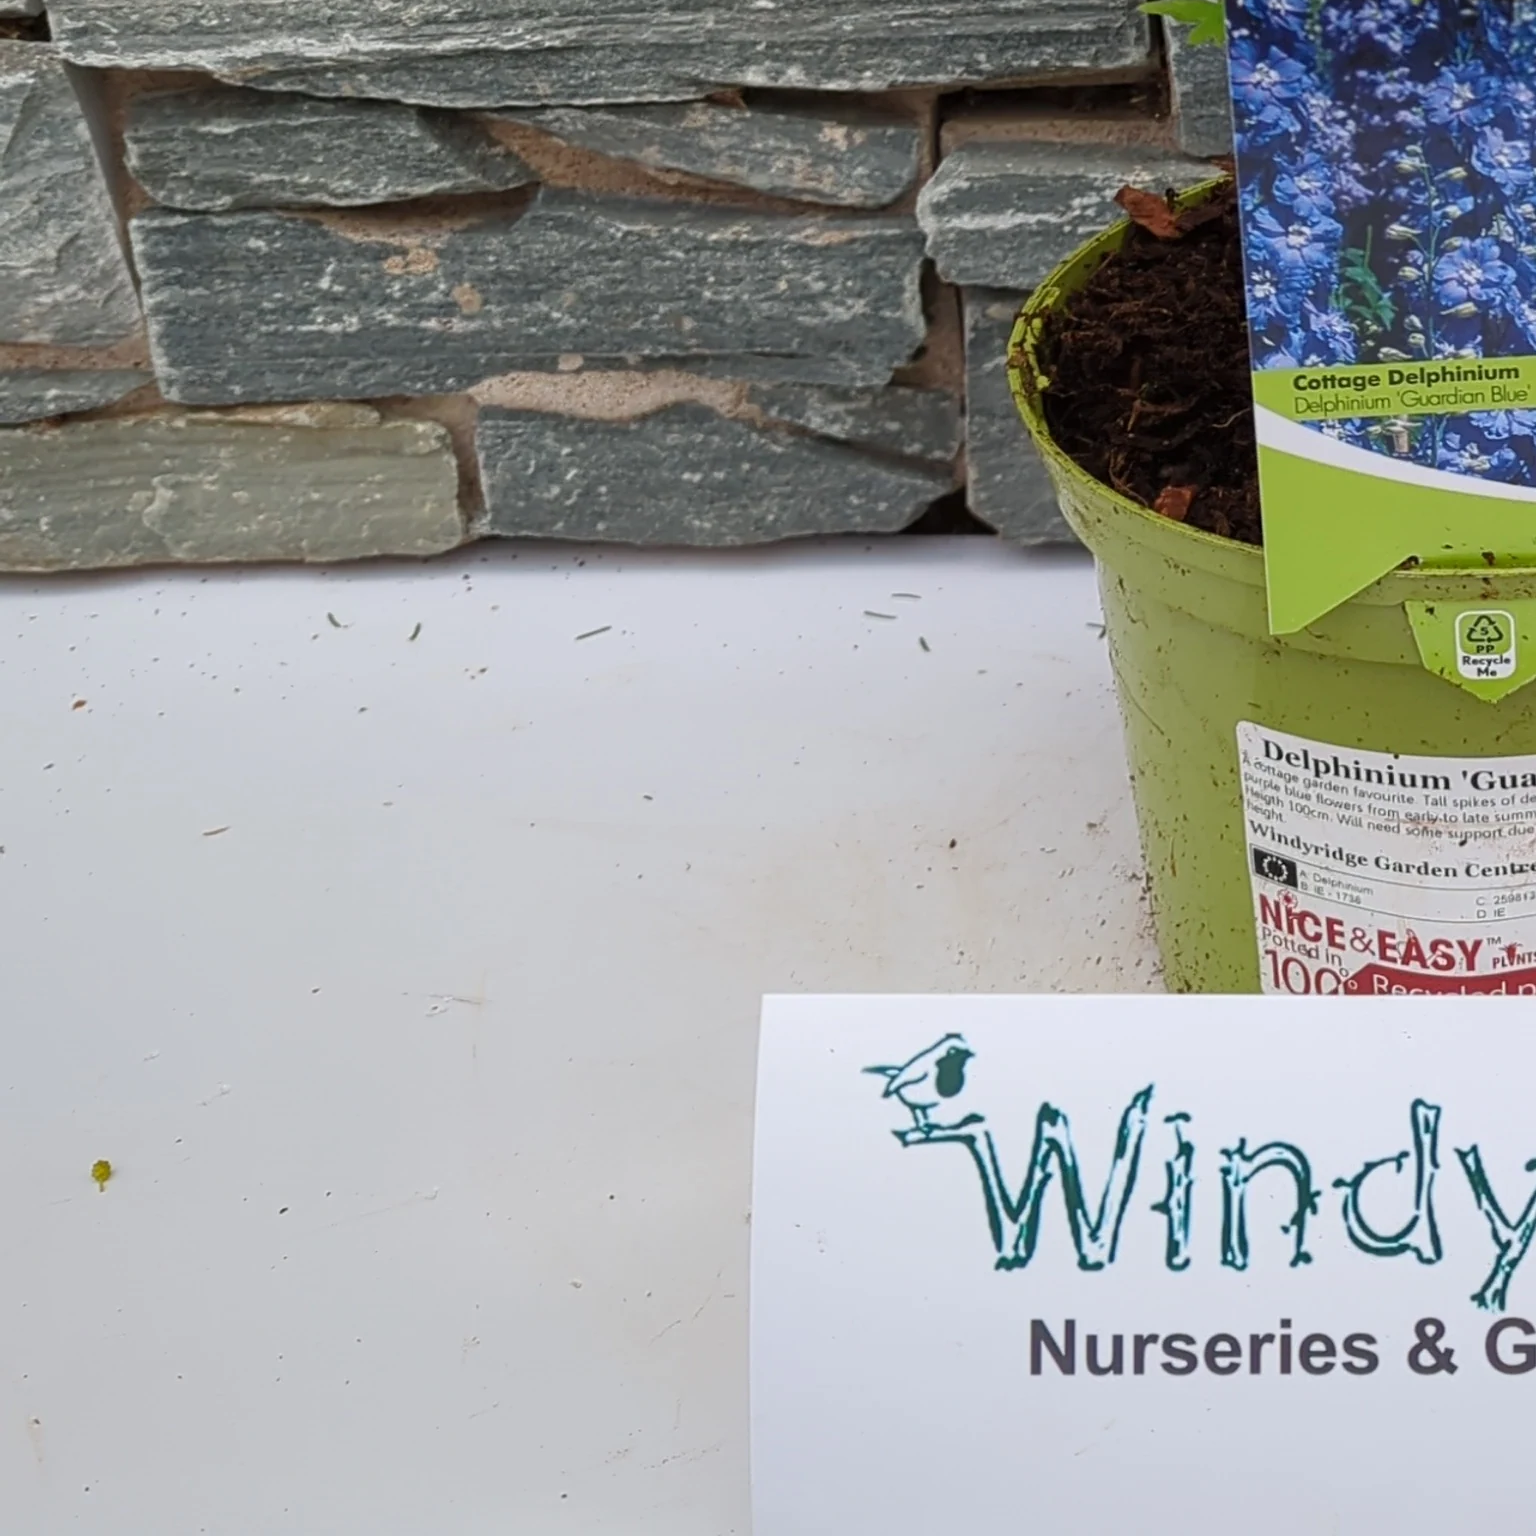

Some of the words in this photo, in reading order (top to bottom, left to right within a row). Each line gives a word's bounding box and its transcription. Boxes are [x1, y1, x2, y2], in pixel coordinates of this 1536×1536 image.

[1293, 371, 1381, 392] Cottage
[1388, 364, 1520, 388] Delphinium
[1294, 391, 1392, 416] Delphinium
[1396, 386, 1487, 408] 'Guardian
[1490, 383, 1533, 404] Blue'
[1462, 654, 1511, 668] Recycle
[1476, 645, 1495, 653] PP
[1477, 667, 1497, 677] Me
[1261, 738, 1452, 791] Delphinium
[1243, 771, 1282, 793] purple
[1284, 784, 1312, 801] blue
[1315, 791, 1364, 813] flowers
[1366, 801, 1399, 819] from
[1403, 809, 1440, 825] early
[1442, 812, 1459, 824] to
[1462, 810, 1491, 824] late
[1252, 758, 1299, 783] cottage
[1302, 776, 1349, 796] garden
[1423, 794, 1448, 807] Tall
[1451, 794, 1497, 810] spikes
[1500, 793, 1516, 807] of
[1335, 814, 1364, 828] Will
[1366, 820, 1401, 835] need
[1405, 825, 1443, 838] some
[1447, 827, 1503, 843] support
[1507, 823, 1535, 837] due
[1248, 819, 1369, 867] Windyridge
[1374, 855, 1458, 878] Garden
[1312, 871, 1374, 896] Delphinium
[1260, 926, 1320, 960] Potted
[1324, 950, 1343, 966] in
[1029, 1317, 1380, 1376] Nurseries
[1406, 1316, 1459, 1376] &
